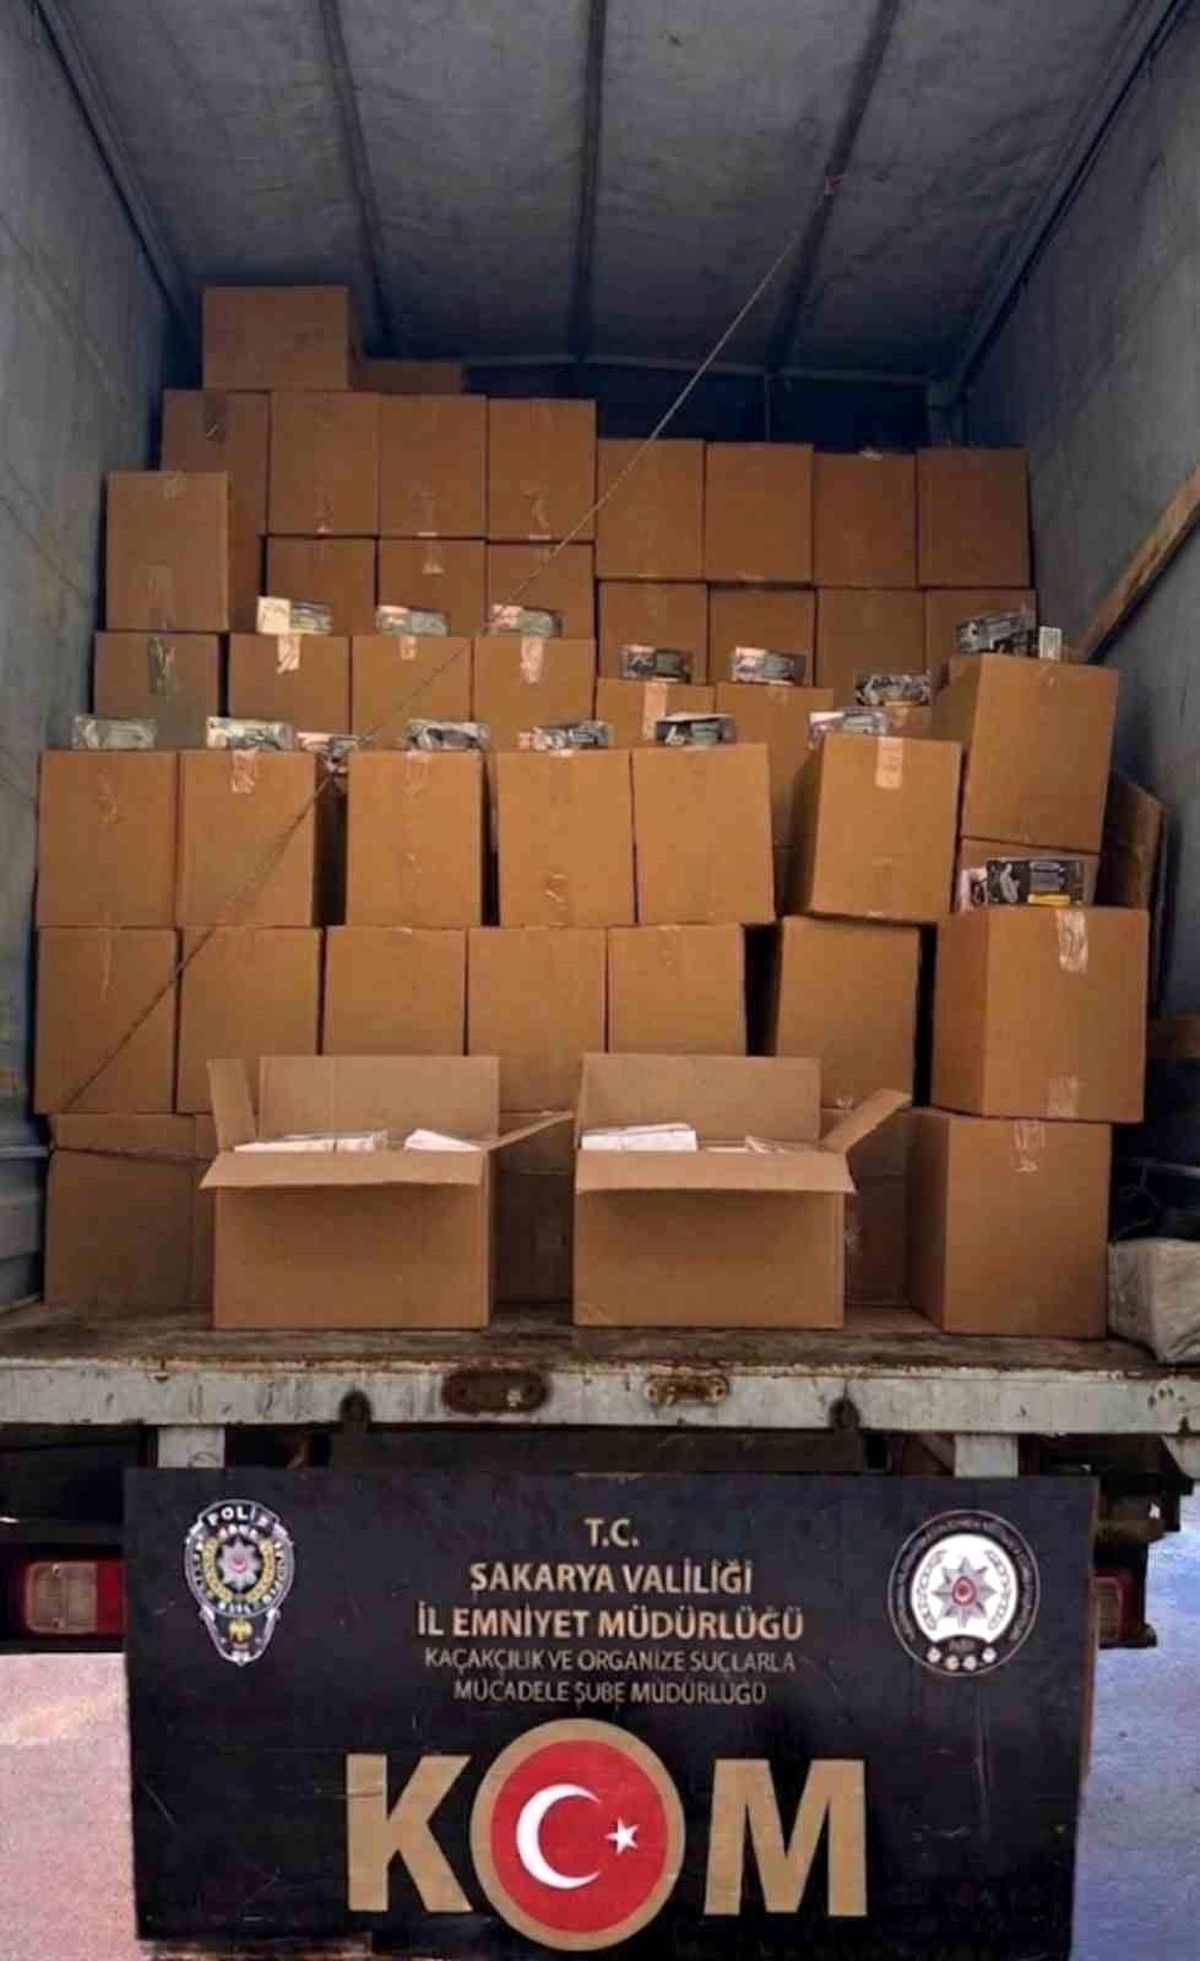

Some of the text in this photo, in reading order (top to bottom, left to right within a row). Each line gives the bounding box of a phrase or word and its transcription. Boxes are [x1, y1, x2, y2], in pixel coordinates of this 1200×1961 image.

[584, 1517, 640, 1548] T.C.
[622, 1557, 753, 1594] VALİLİĞİ
[418, 1600, 804, 1641] İL EMNİYET MÜDÜRLÜĞÜ
[425, 1648, 543, 1677] KAÇAKÇILIK
[548, 1650, 573, 1671] VE
